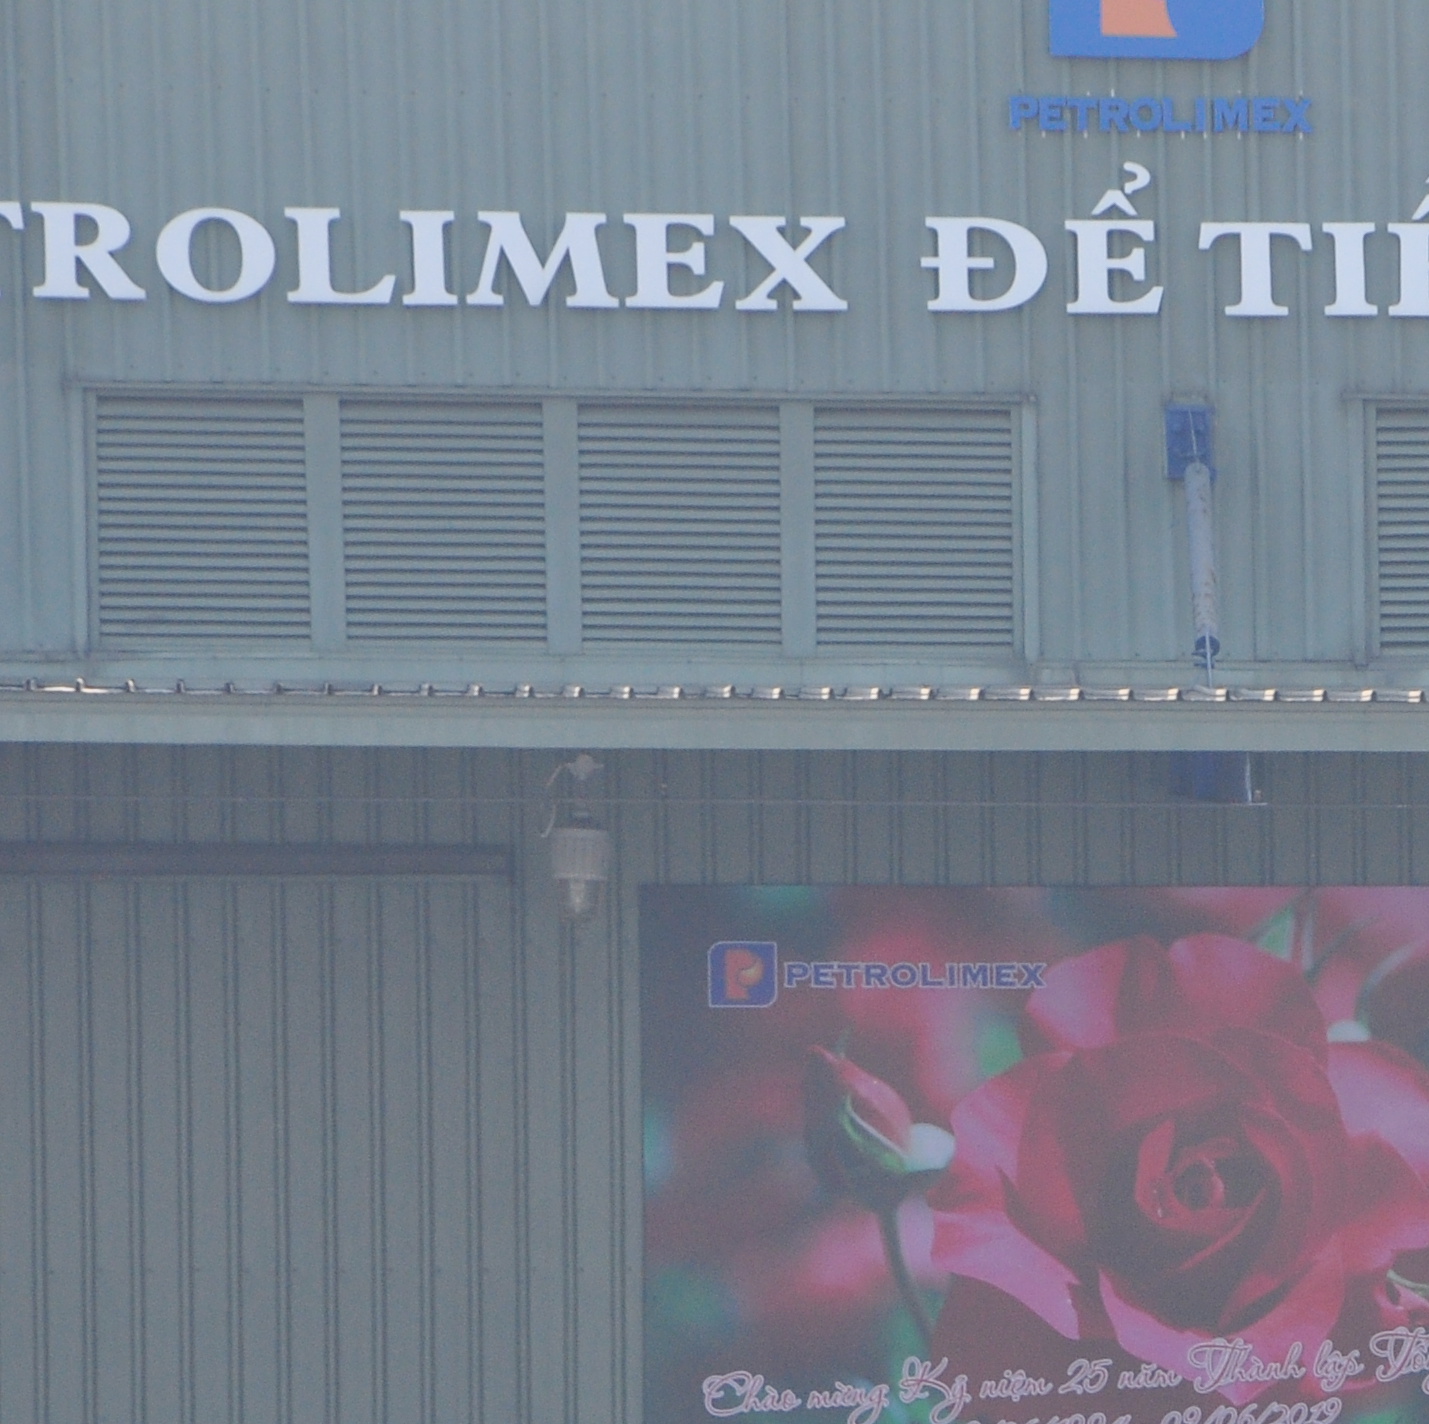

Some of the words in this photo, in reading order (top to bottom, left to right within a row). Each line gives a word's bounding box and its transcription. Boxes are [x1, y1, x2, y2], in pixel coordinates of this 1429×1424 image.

[1009, 96, 1312, 134] PETROLIMEX
[0, 200, 848, 312] ROLIMEX
[920, 161, 1164, 314] ĐỂ
[783, 961, 1048, 989] PETROLIMEX
[702, 1370, 802, 1418] Chào
[979, 1368, 1054, 1402] niệm
[1057, 1358, 1113, 1394] 25
[1117, 1358, 1183, 1390] năm
[1187, 1337, 1306, 1394] Thành
[1313, 1339, 1365, 1393] lập
